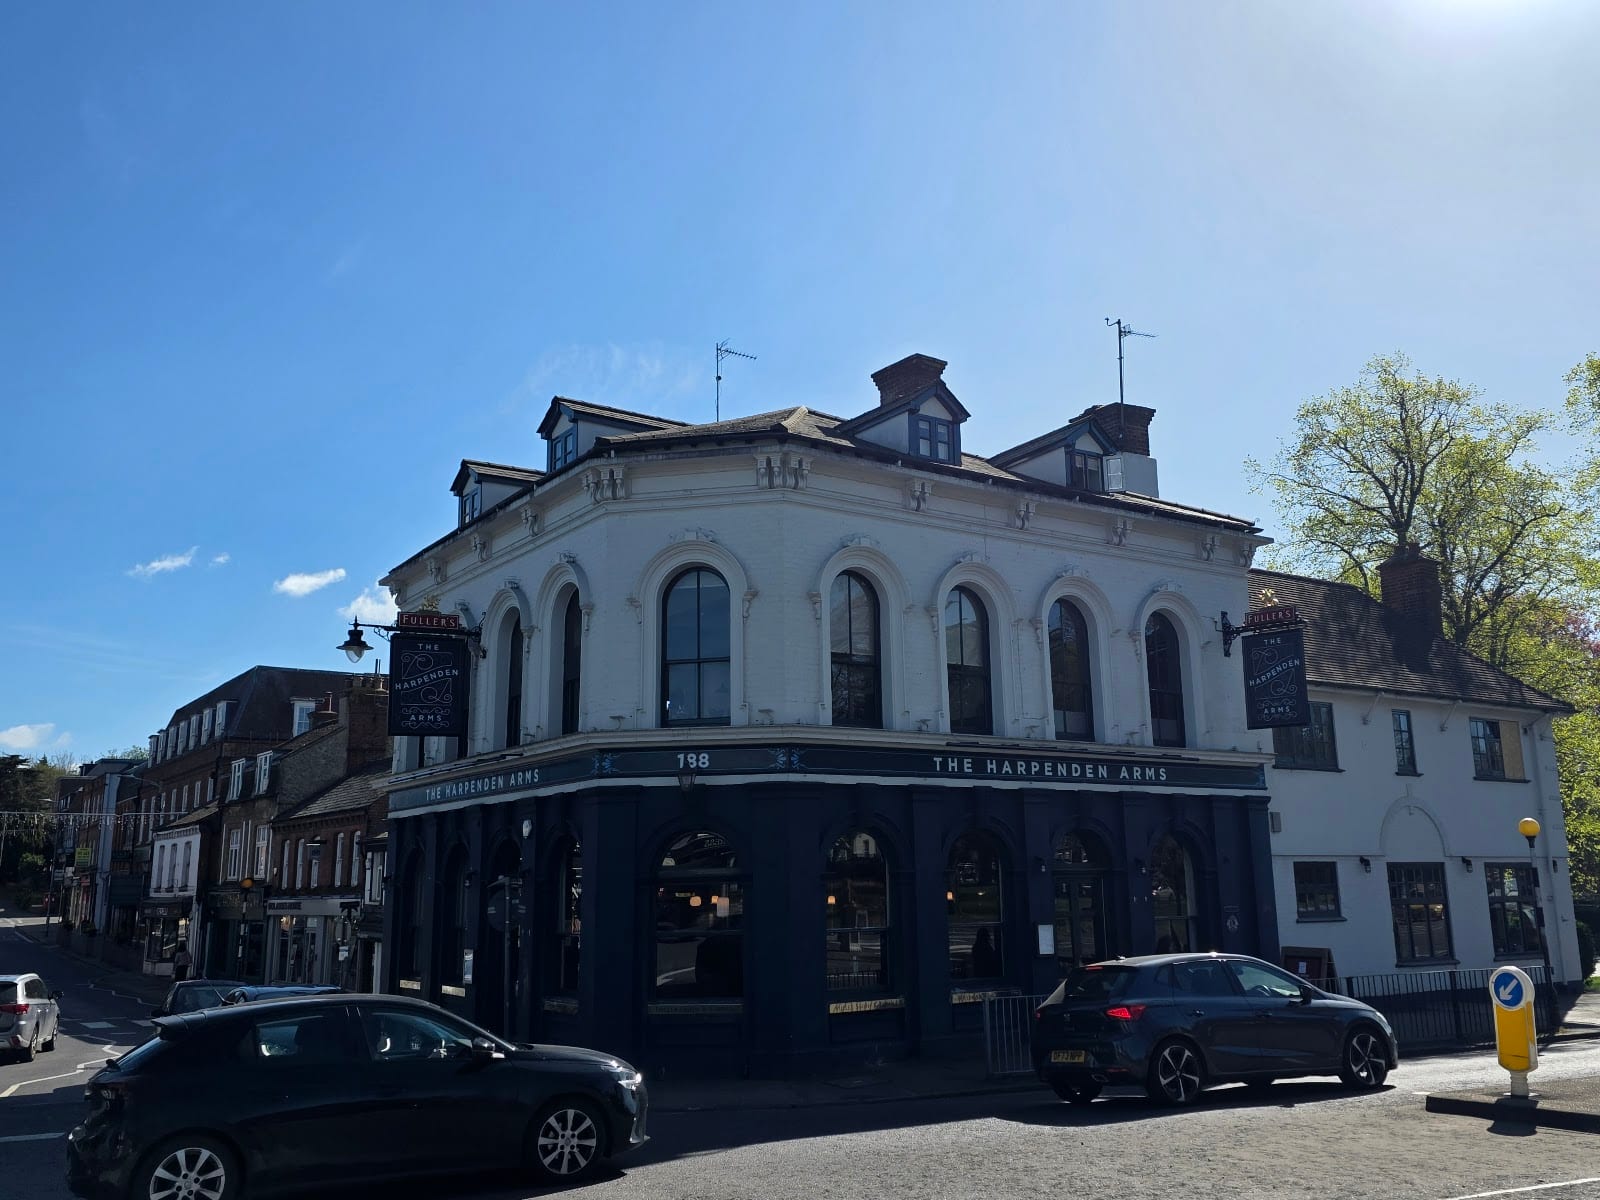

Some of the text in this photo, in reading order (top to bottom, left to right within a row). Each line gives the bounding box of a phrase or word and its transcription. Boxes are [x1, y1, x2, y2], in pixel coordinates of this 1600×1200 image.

[402, 614, 456, 628] FULLER'S
[1247, 609, 1292, 624] FULLER'S
[417, 643, 440, 651] THE
[1263, 637, 1282, 646] THE
[394, 669, 459, 690] HARPENDEN
[1249, 658, 1301, 687] HARPENDEN
[1264, 705, 1291, 714] ARMS
[933, 756, 1168, 782] THE HARPENDEN ARMS
[425, 768, 541, 801] THE HARPENDEN ARMS
